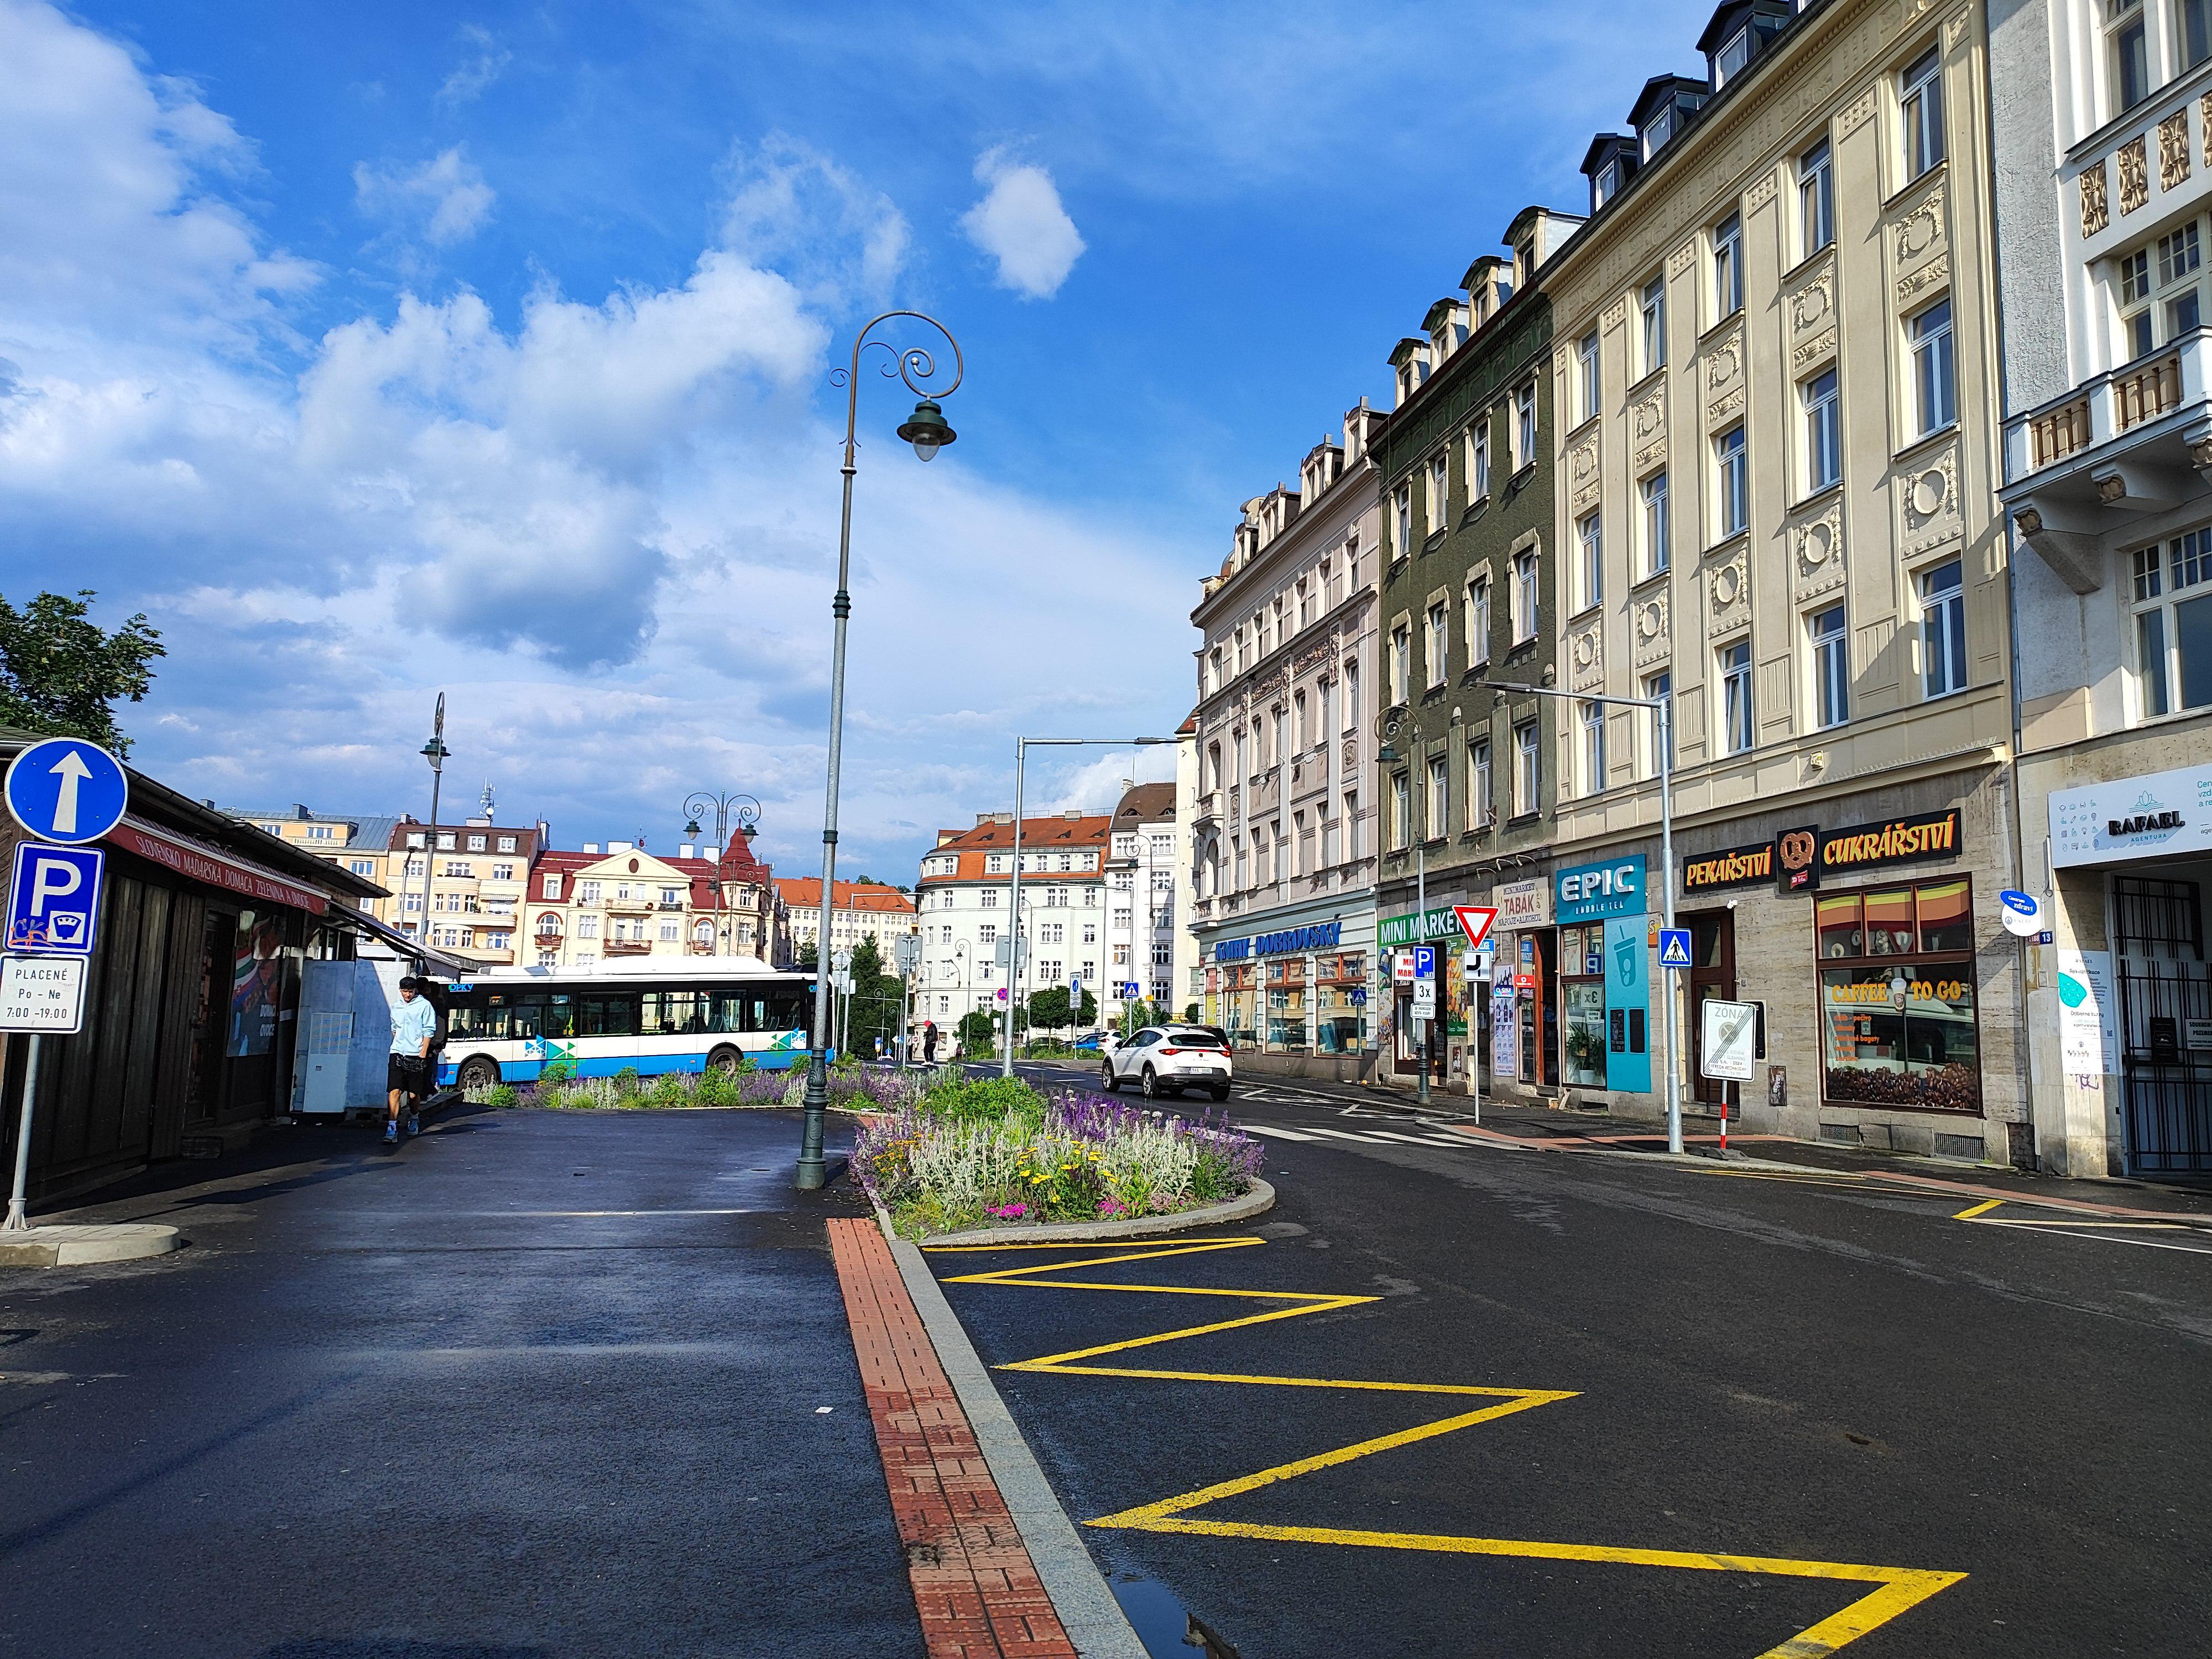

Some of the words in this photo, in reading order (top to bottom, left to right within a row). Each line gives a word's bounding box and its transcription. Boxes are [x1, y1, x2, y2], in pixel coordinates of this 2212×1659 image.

[2107, 811, 2185, 836] RAFAEL
[1824, 813, 1955, 865] CUKRÁŘSTVÍ
[2131, 833, 2167, 842] AGENTURA
[135, 835, 181, 868] SLOVENSKO
[285, 889, 291, 903] A
[1687, 846, 1772, 886] PEKAŘSTVÍ
[30, 858, 81, 917] P
[1503, 883, 1535, 895] MINIMARKET
[1562, 865, 1635, 901] EPIC
[1504, 893, 1534, 916] TABÁK
[1381, 919, 1406, 943] MINI
[2042, 933, 2051, 942] 13
[1418, 950, 1431, 969] P
[15, 968, 68, 980] PLACENÉ
[19, 988, 32, 999] Po
[49, 989, 61, 1000] Ne
[450, 983, 473, 992] DPKV
[1419, 985, 1431, 998] 3x
[1832, 983, 1889, 1003] CAFFEE
[1911, 981, 1933, 1001] TO
[1937, 980, 1961, 1001] GO
[7, 1007, 29, 1019] 7:00
[1715, 1005, 1743, 1020] ZÓNA
[1853, 1014, 1872, 1023] pečivo
